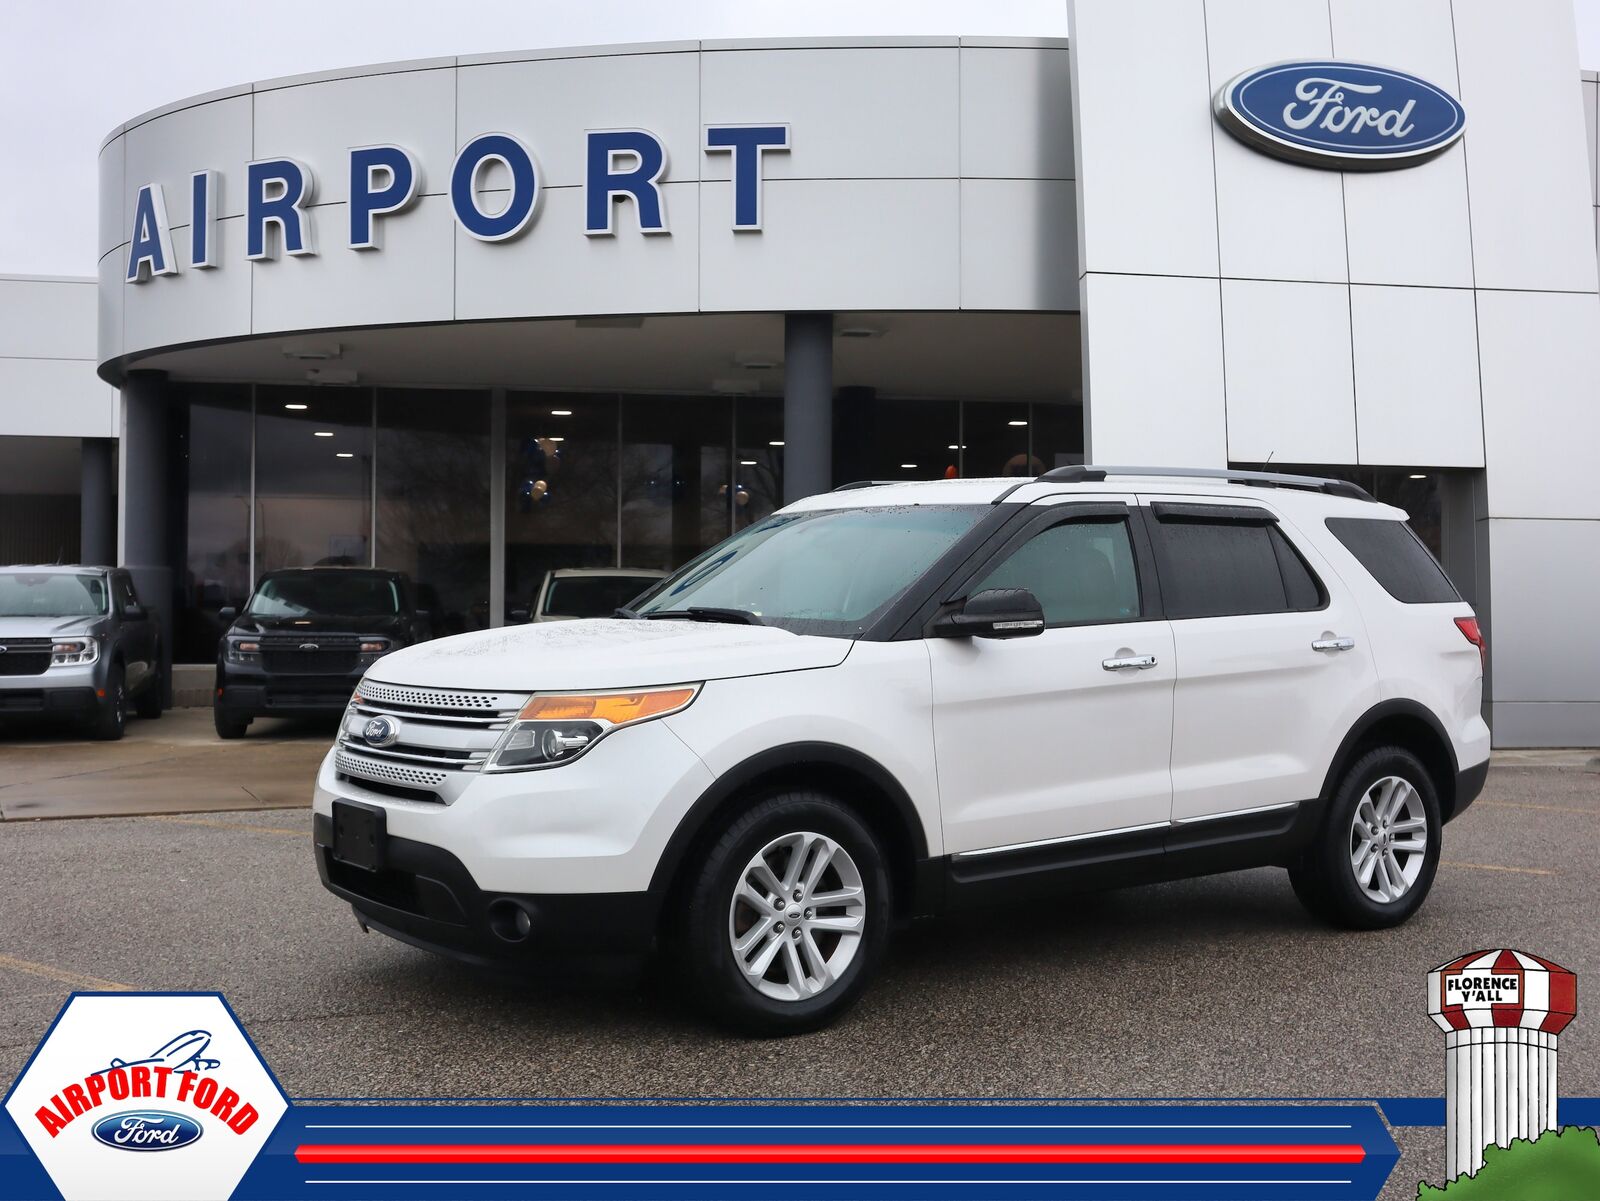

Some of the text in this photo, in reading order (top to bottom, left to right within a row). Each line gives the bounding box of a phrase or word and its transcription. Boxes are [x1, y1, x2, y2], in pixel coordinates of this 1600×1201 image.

[1283, 77, 1416, 138] Ford
[125, 123, 791, 284] AIRPORT
[365, 720, 385, 737] Ford
